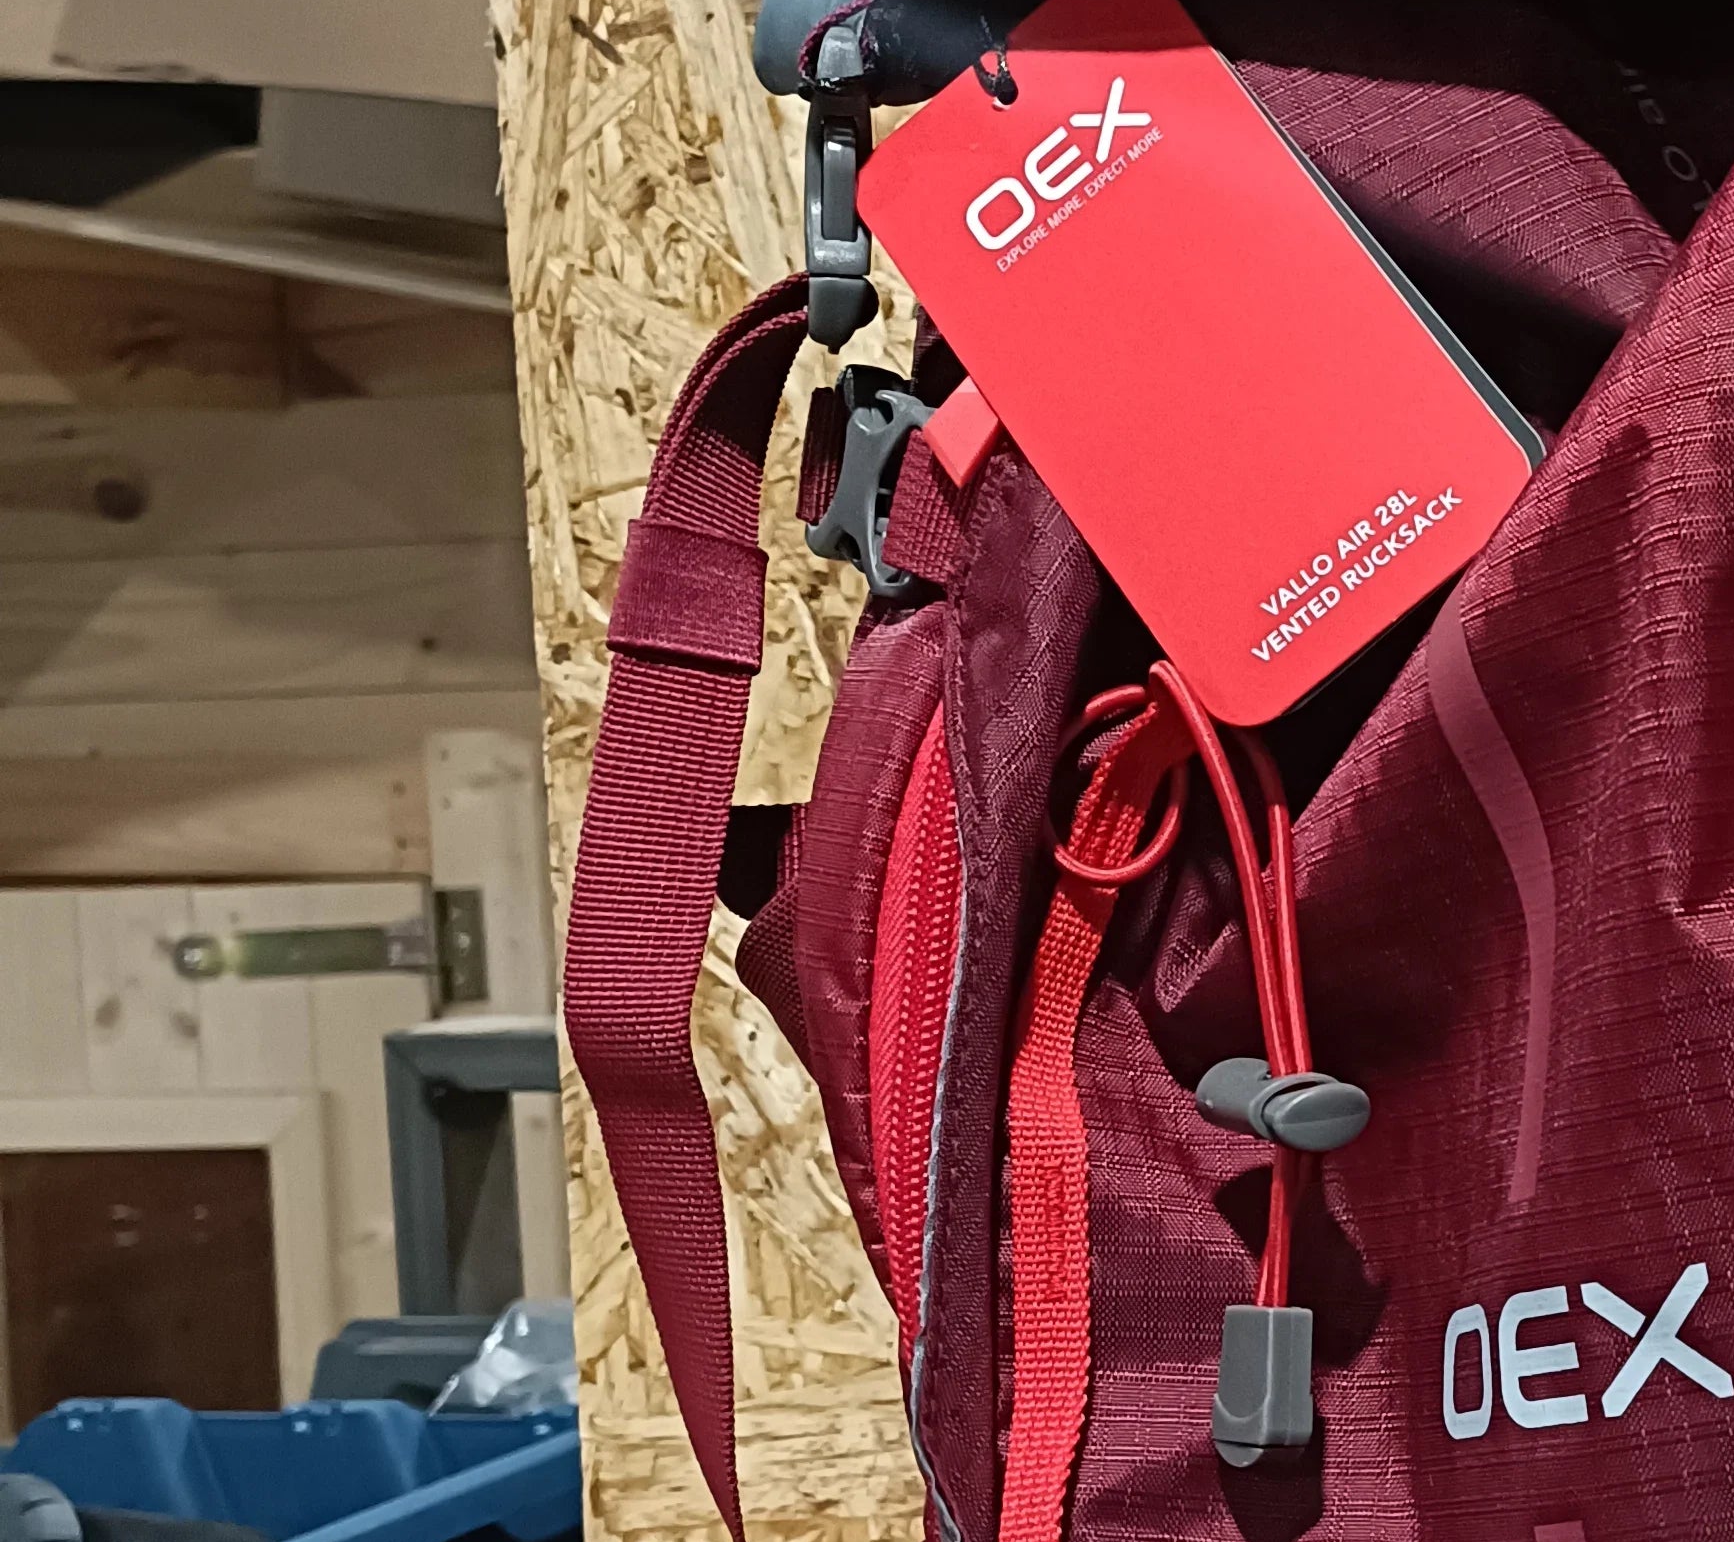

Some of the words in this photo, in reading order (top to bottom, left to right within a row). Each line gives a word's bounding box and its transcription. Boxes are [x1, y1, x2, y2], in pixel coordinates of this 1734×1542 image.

[966, 76, 1152, 250] OEX
[996, 224, 1049, 273] EXPLORE
[1083, 155, 1129, 199] EXPECT
[1127, 126, 1164, 161] MORE
[1250, 586, 1341, 662] VENTED
[1340, 486, 1463, 591] RUCKSACK
[1259, 554, 1334, 616] VALLO
[1337, 520, 1376, 560] AIR
[1374, 489, 1418, 527] 28L
